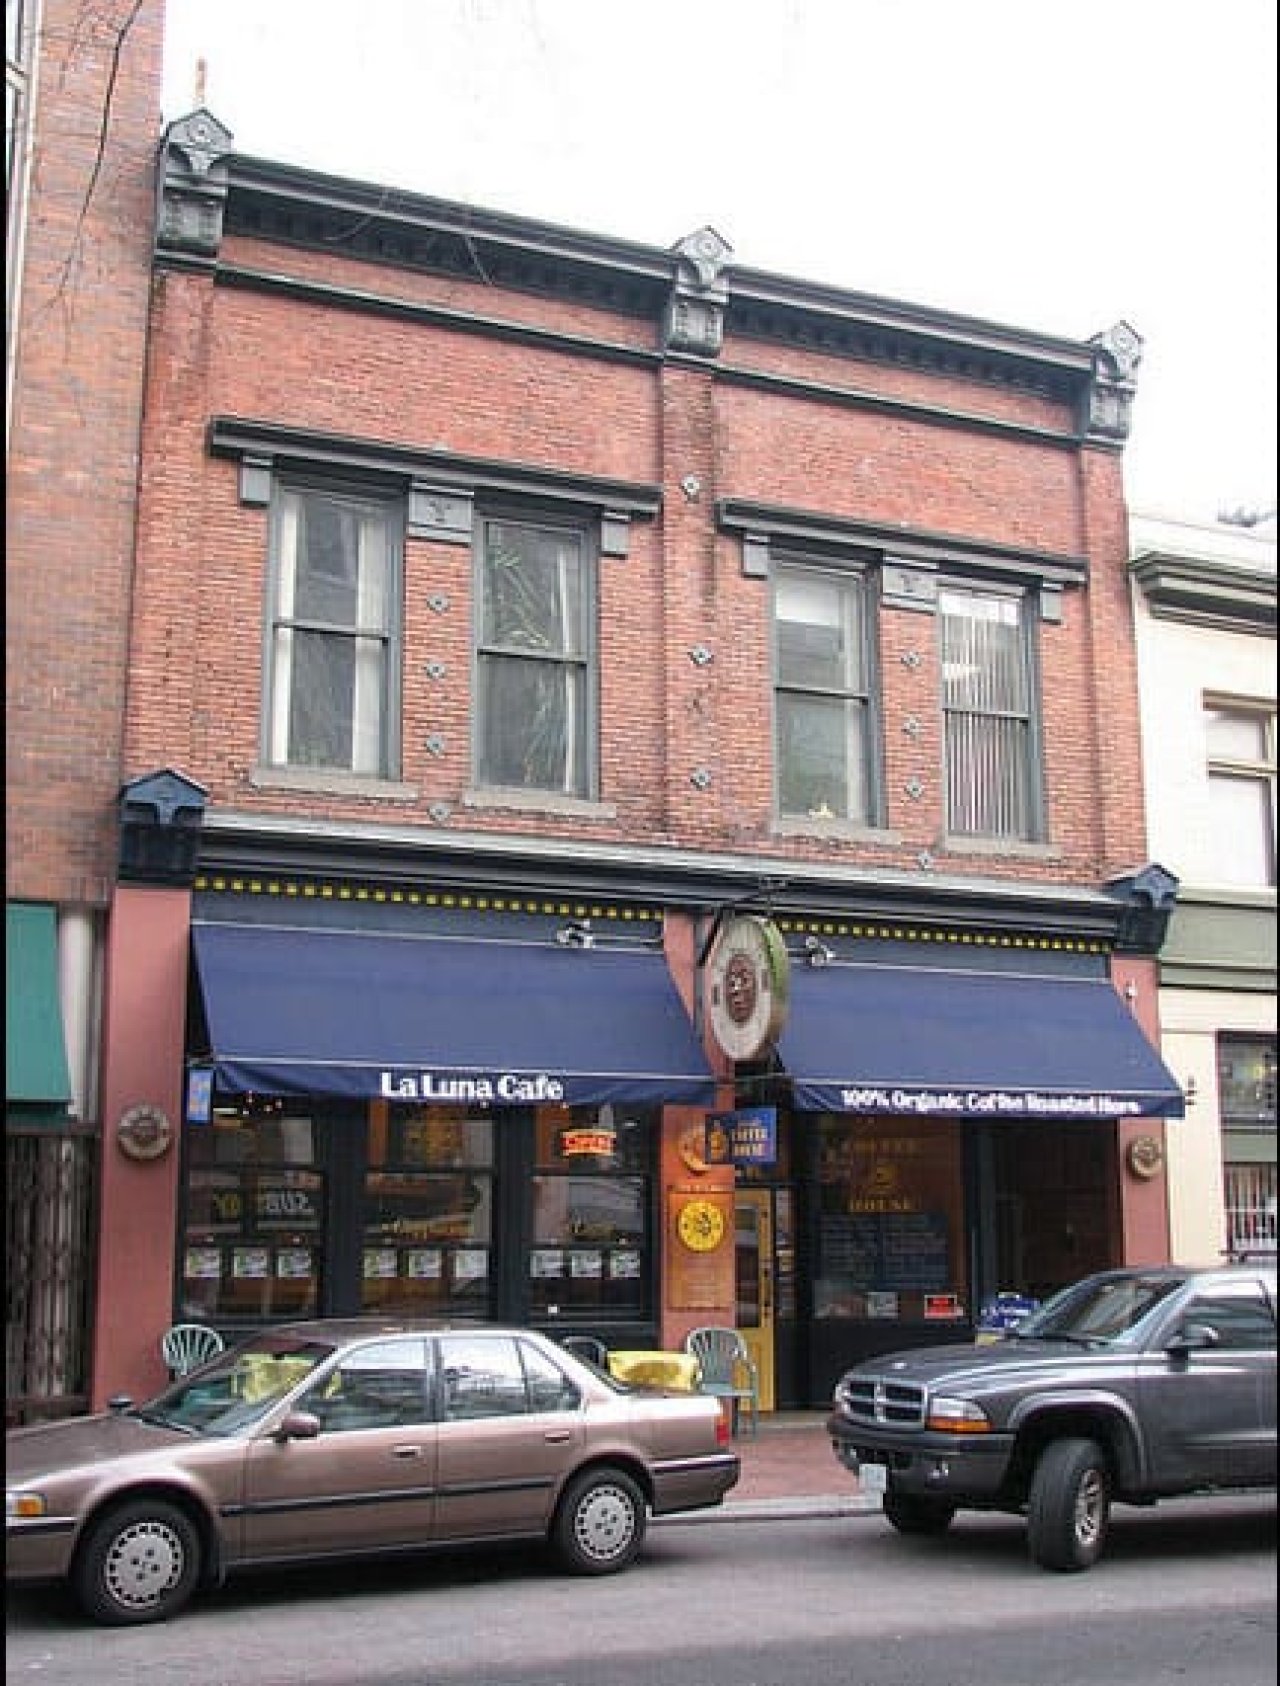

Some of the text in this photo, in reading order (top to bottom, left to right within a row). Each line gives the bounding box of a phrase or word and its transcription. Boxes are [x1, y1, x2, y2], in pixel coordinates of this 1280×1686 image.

[381, 1072, 564, 1100] La Luna Cafe
[841, 1090, 889, 1109] 100%
